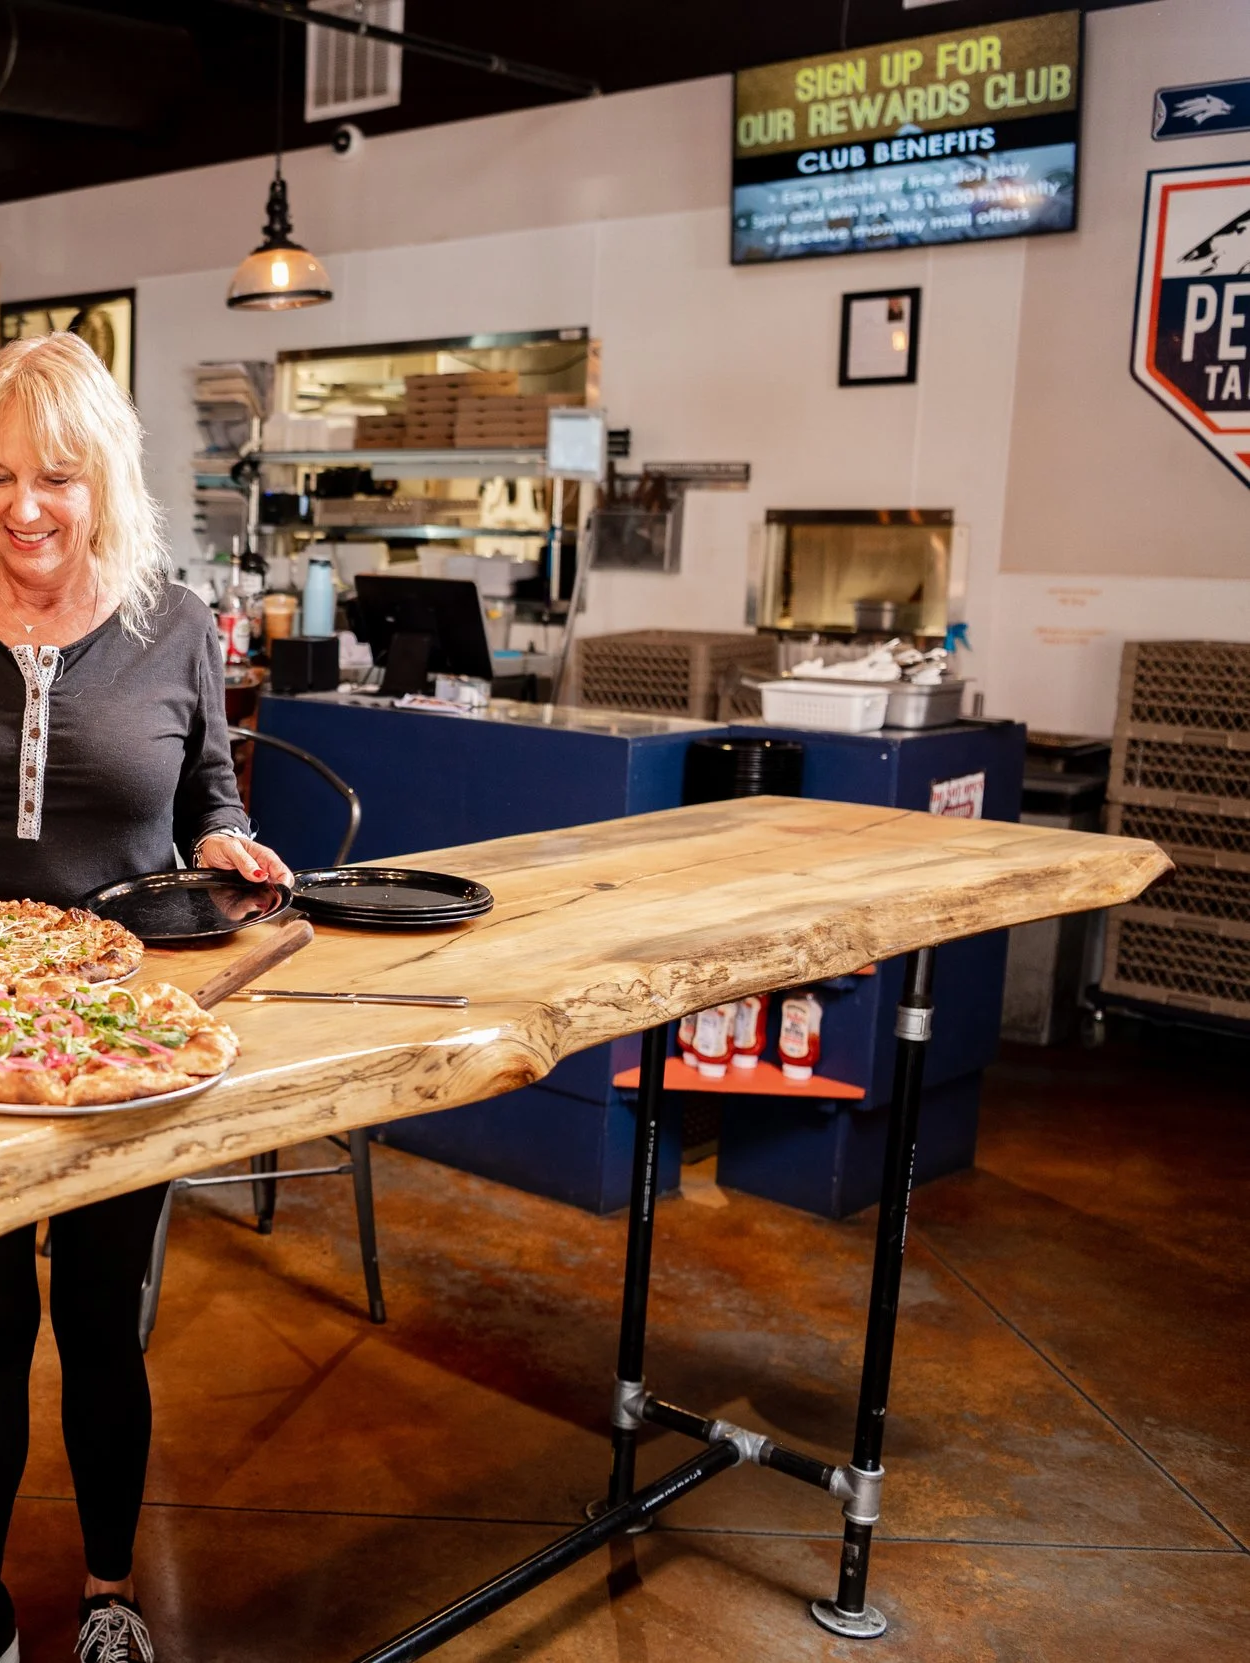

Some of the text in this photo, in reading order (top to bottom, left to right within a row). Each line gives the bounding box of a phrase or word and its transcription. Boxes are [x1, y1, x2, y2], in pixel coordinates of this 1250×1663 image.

[795, 35, 1002, 102] SIGN UP FOR
[737, 64, 1071, 148] OUR REWARDS CLUB
[797, 127, 996, 175] CLUB BENEFITS
[781, 161, 1030, 206] Earn points for free slot play
[790, 206, 825, 225] and
[829, 206, 860, 221] win
[891, 199, 911, 214] to
[978, 178, 1061, 205] instantly
[779, 196, 1031, 246] Receive monthly mail offers
[1204, 365, 1250, 401] TA
